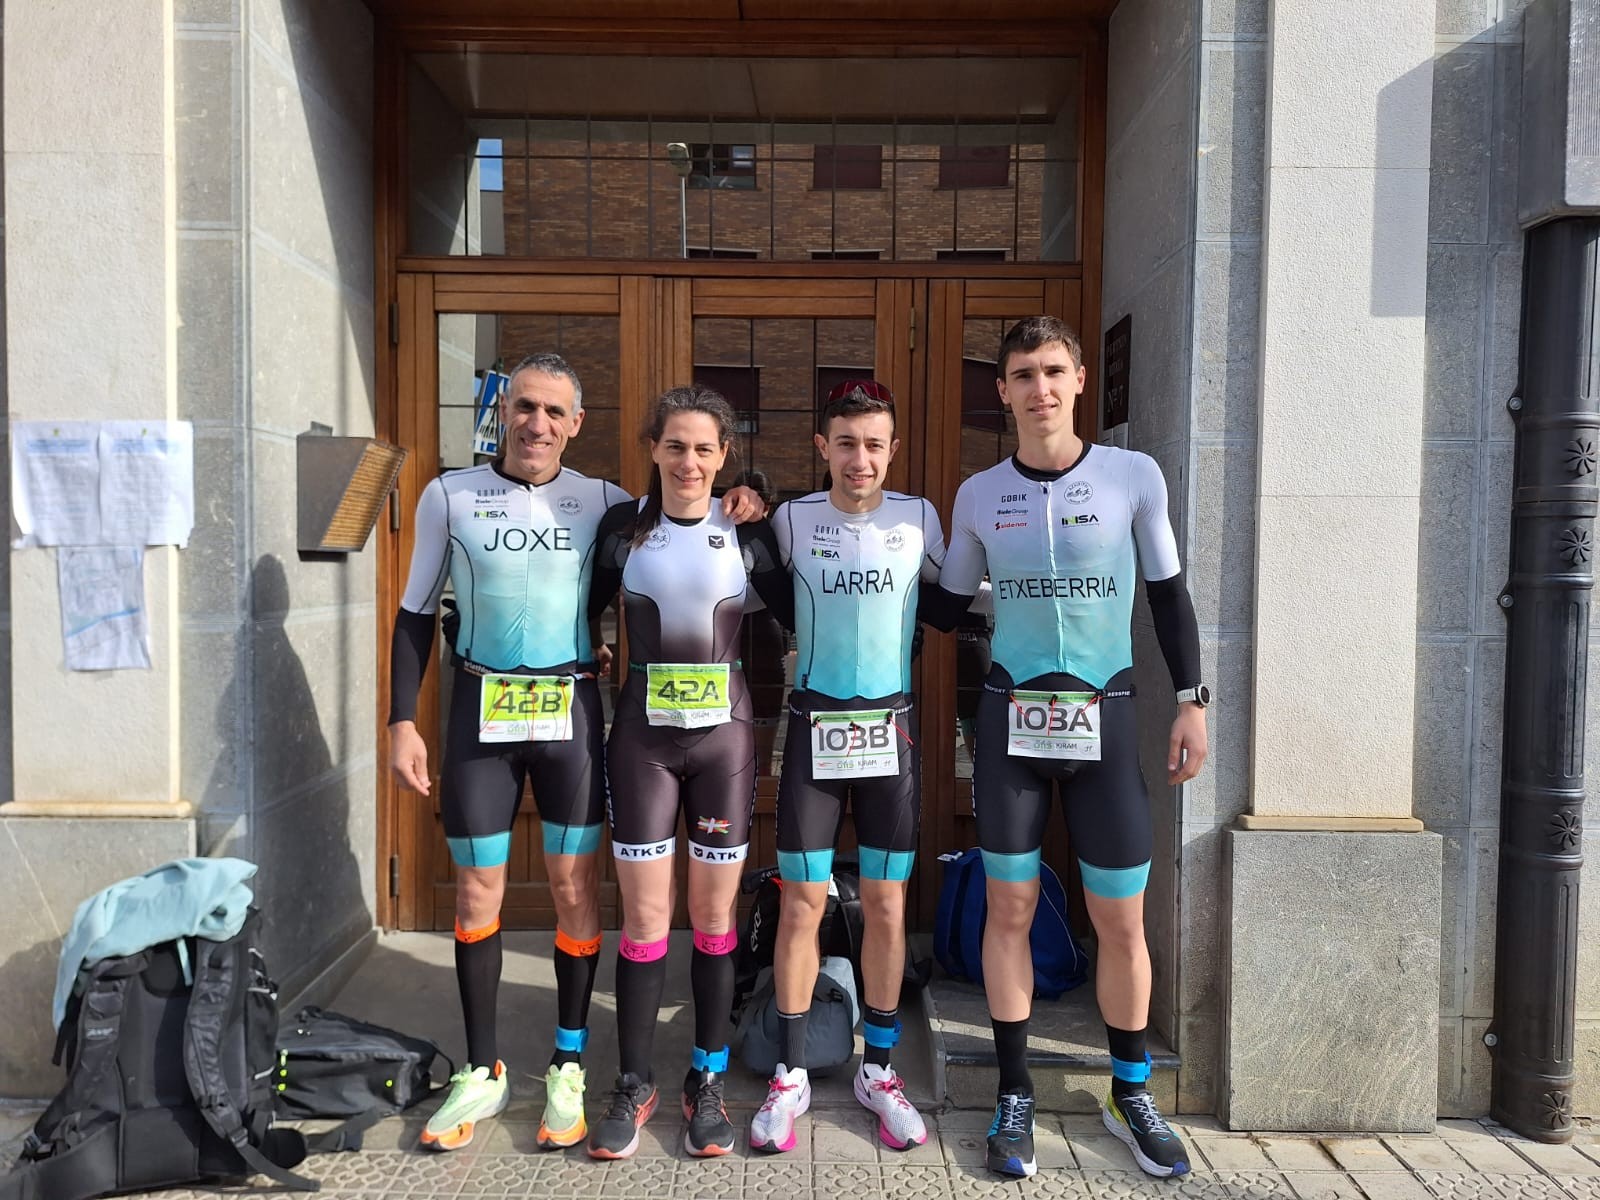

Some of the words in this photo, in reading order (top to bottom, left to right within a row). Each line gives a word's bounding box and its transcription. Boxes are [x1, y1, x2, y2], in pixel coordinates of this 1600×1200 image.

[1001, 493, 1027, 504] GOBIK
[484, 528, 572, 551] JOXE
[822, 567, 894, 595] LARRA
[999, 576, 1118, 600] ETXEBERRIA
[492, 691, 562, 713] 42B
[658, 680, 720, 702] 42A
[1016, 706, 1093, 732] 103A
[818, 725, 890, 751] 103B
[620, 847, 653, 857] ATK
[706, 851, 738, 860] ATK
